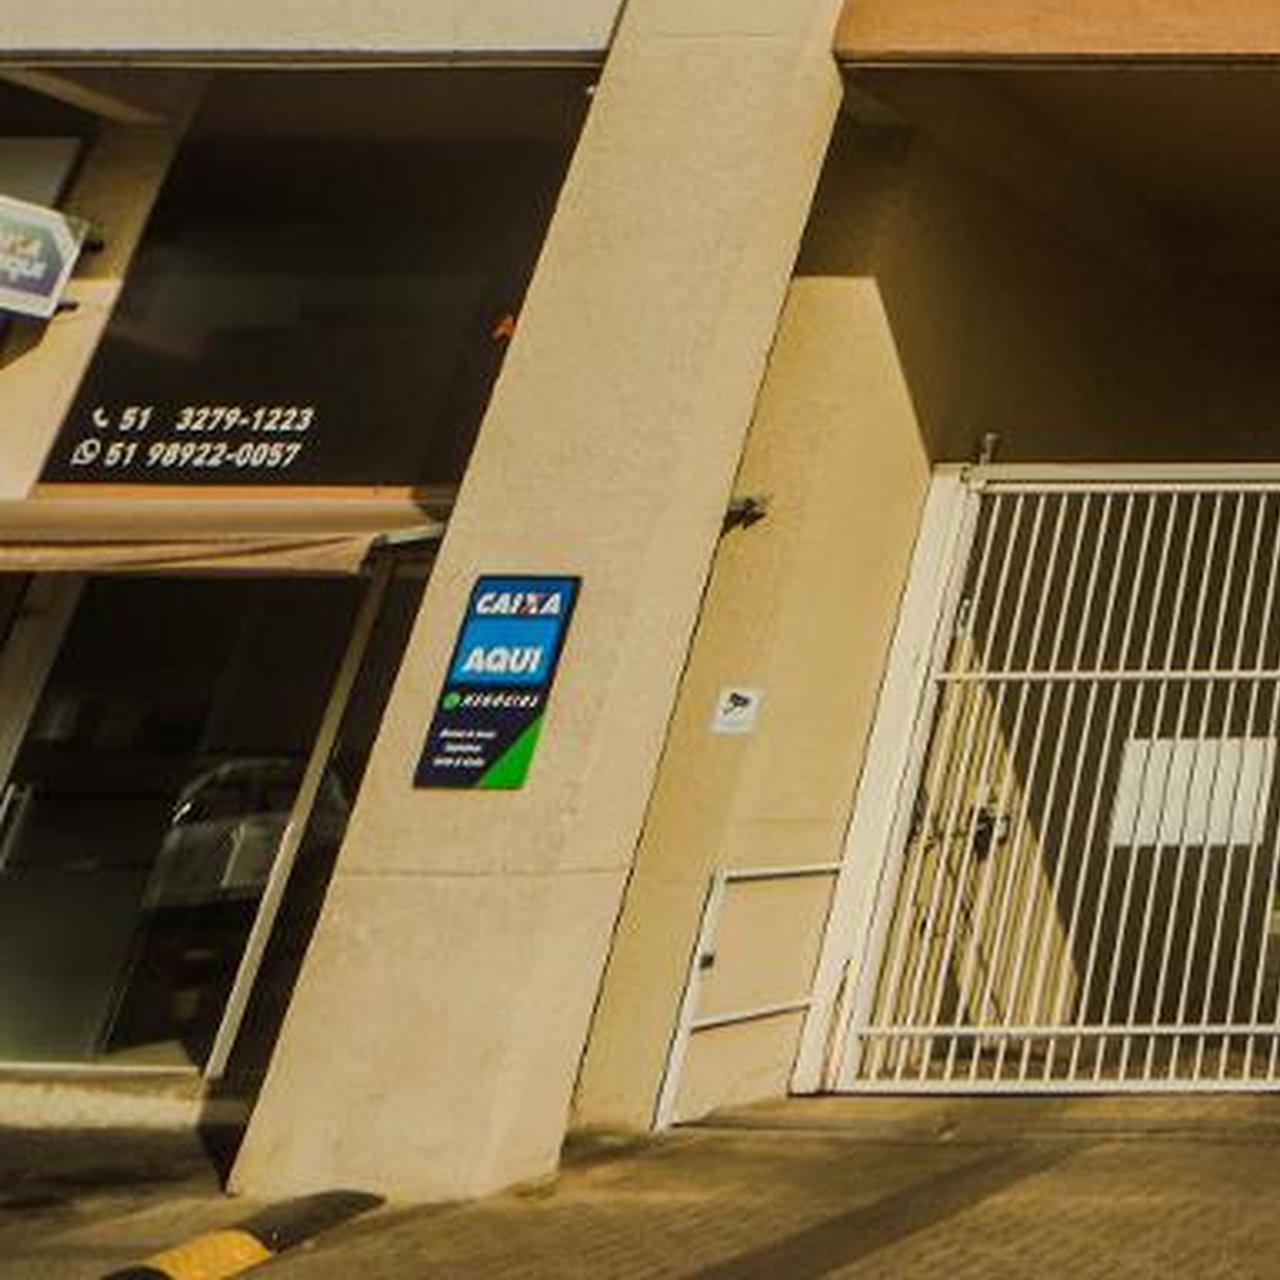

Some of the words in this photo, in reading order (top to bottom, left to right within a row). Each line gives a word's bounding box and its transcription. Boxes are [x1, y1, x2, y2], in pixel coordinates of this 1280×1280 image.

[119, 406, 152, 431] 51
[175, 406, 315, 431] 3279-1223
[104, 442, 138, 467] 51
[147, 442, 301, 467] 98922-0057
[476, 592, 562, 616] CAIXA
[460, 645, 543, 674] AQUI
